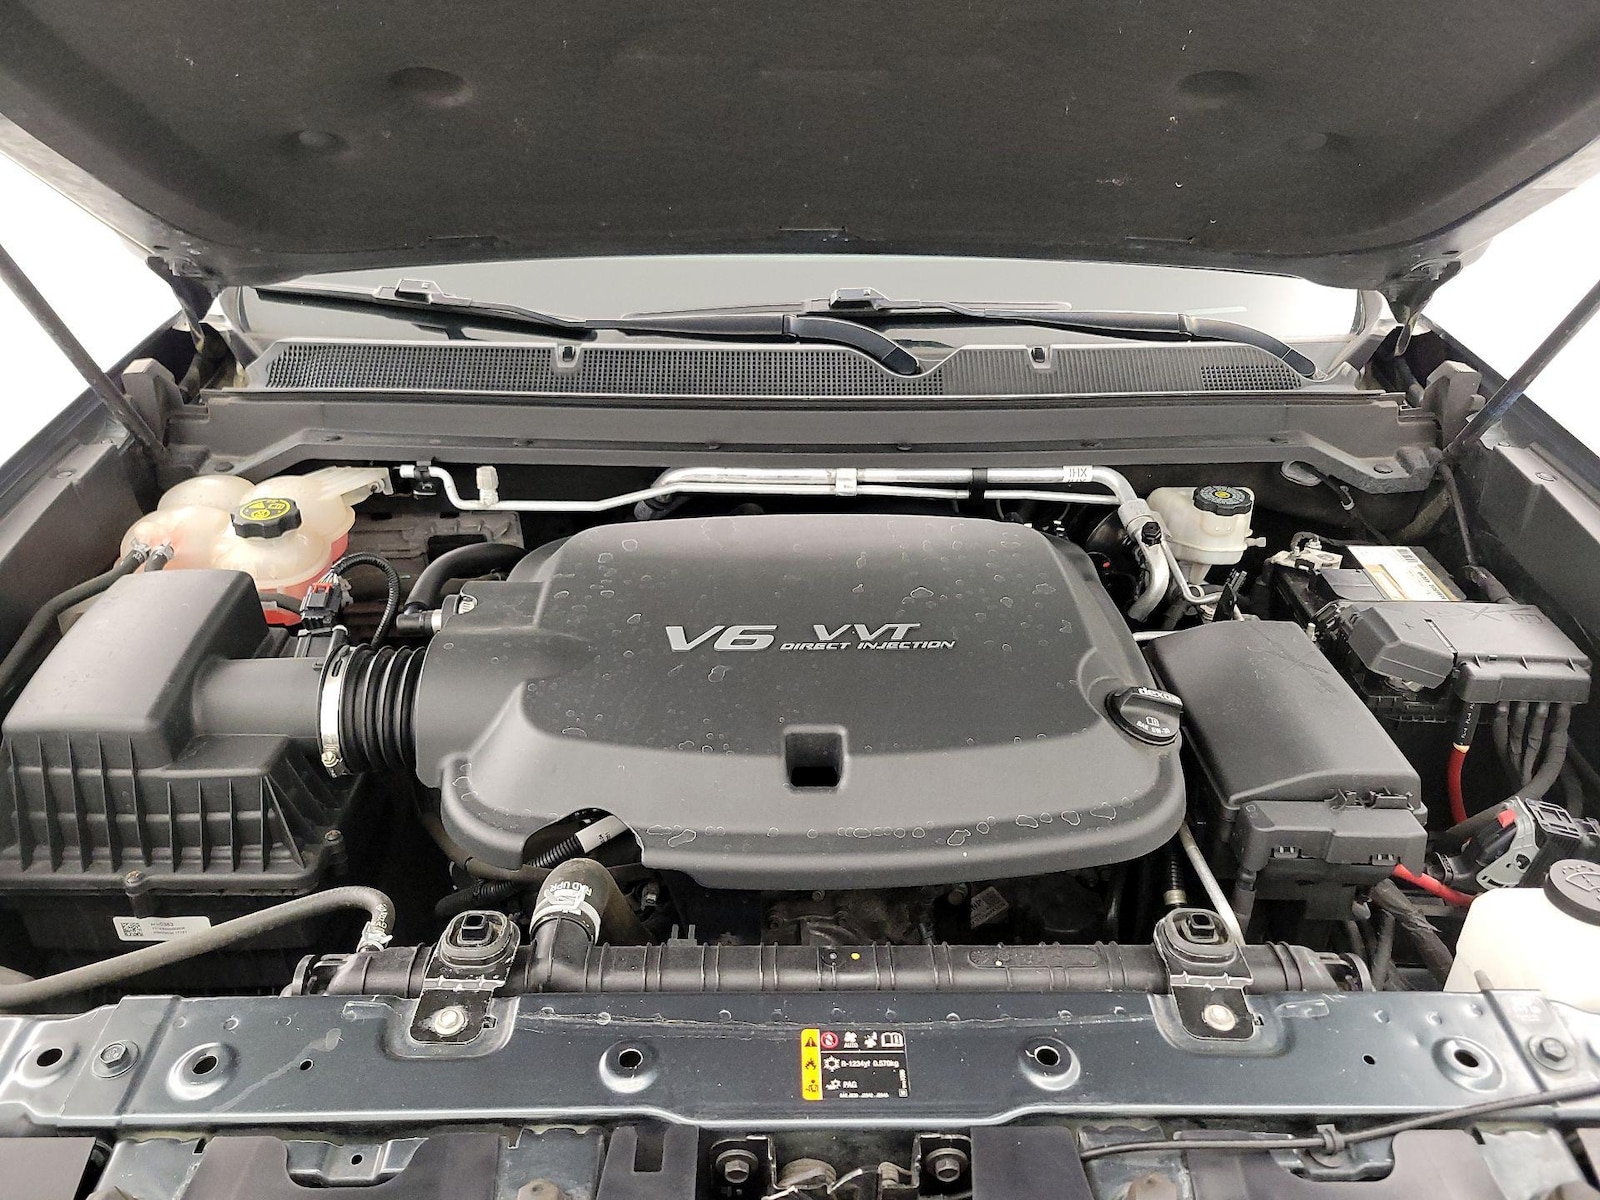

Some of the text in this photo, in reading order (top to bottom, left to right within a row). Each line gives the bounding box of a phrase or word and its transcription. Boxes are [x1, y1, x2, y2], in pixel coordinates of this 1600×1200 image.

[665, 623, 921, 652] V6 VVT
[779, 640, 956, 651] DIRECT INJECTION
[842, 1080, 858, 1089] PAG
